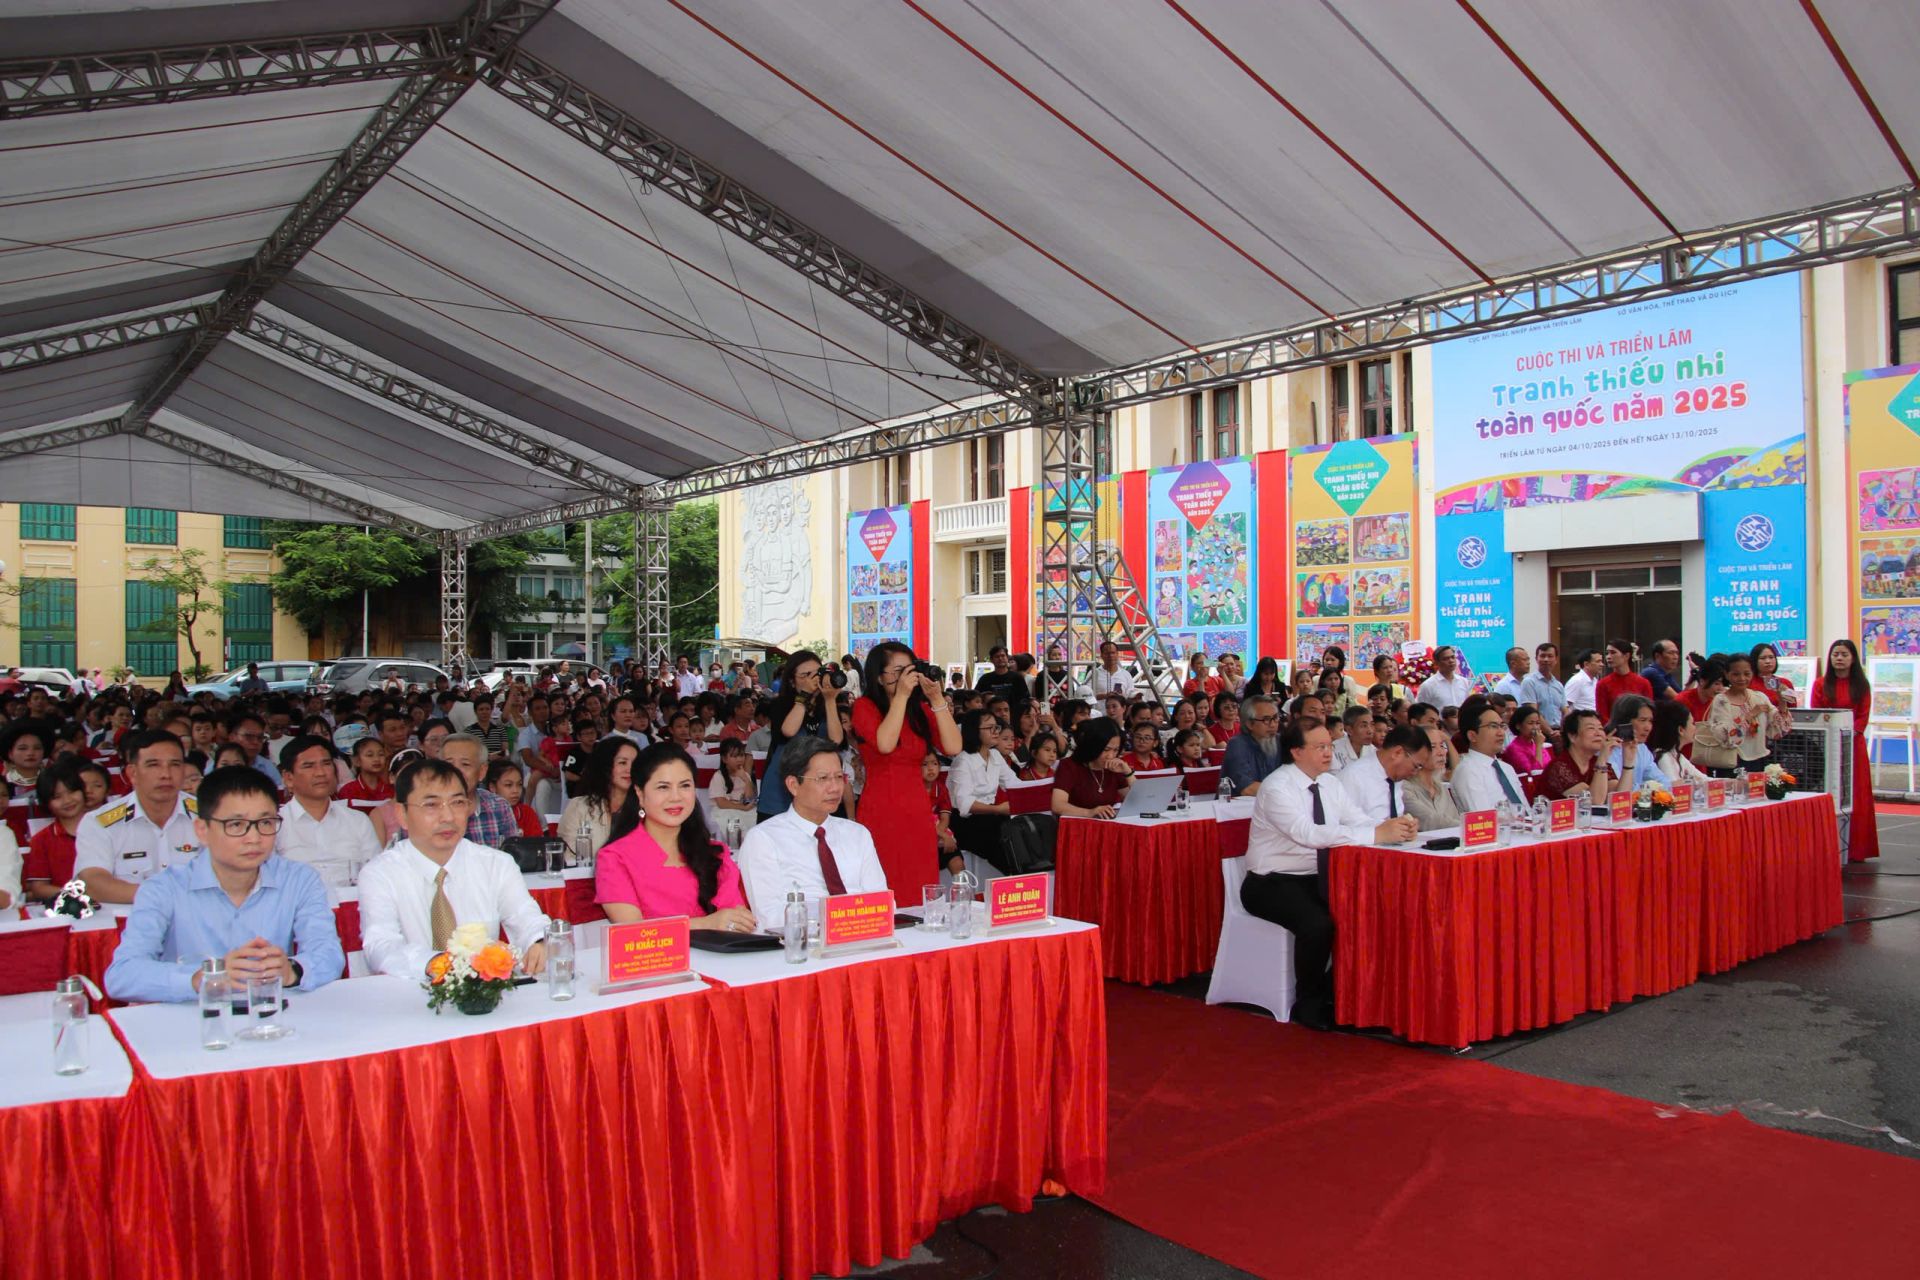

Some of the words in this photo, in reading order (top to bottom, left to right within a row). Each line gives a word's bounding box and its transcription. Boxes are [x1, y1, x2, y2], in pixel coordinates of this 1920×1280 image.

[1676, 296, 1696, 305] THAO
[1516, 350, 1554, 373] CUỘC
[1558, 346, 1581, 365] THI
[1585, 341, 1605, 361] VÀ
[1610, 329, 1653, 356] TRIỂN
[1658, 328, 1692, 349] LÃM
[1492, 376, 1574, 407] Tranh
[1584, 355, 1664, 393] thiếu
[1677, 351, 1725, 380] nhi
[1475, 411, 1534, 439] toàn
[1542, 397, 1605, 433] quốc
[1613, 392, 1663, 422] năm
[1674, 383, 1748, 414] 2025
[1568, 439, 1611, 452] 04/10/2025
[1671, 427, 1718, 439] 13/10/2025
[1323, 475, 1345, 484] TRANH
[1730, 580, 1780, 592] TRANH
[1454, 593, 1491, 604] TRANH
[1712, 593, 1752, 607] thiếu
[1757, 594, 1780, 606] nhi
[1440, 604, 1471, 616] thiếu
[1474, 605, 1492, 616] nhi
[1731, 608, 1762, 620] toàn
[1766, 606, 1798, 620] quốc
[1455, 617, 1479, 628] toàn
[1481, 615, 1506, 628] quốc
[1731, 623, 1750, 632] năm
[1751, 623, 1778, 632] 2025
[1455, 630, 1470, 638] năm
[1470, 630, 1491, 638] 2025
[564, 754, 577, 767] P
[998, 892, 1007, 904] LÊ
[1008, 892, 1021, 903] ANH
[640, 928, 658, 938] ÔNG
[624, 942, 634, 952] VŨ
[636, 937, 656, 950] KHẮC
[657, 937, 674, 949] LỊCH
